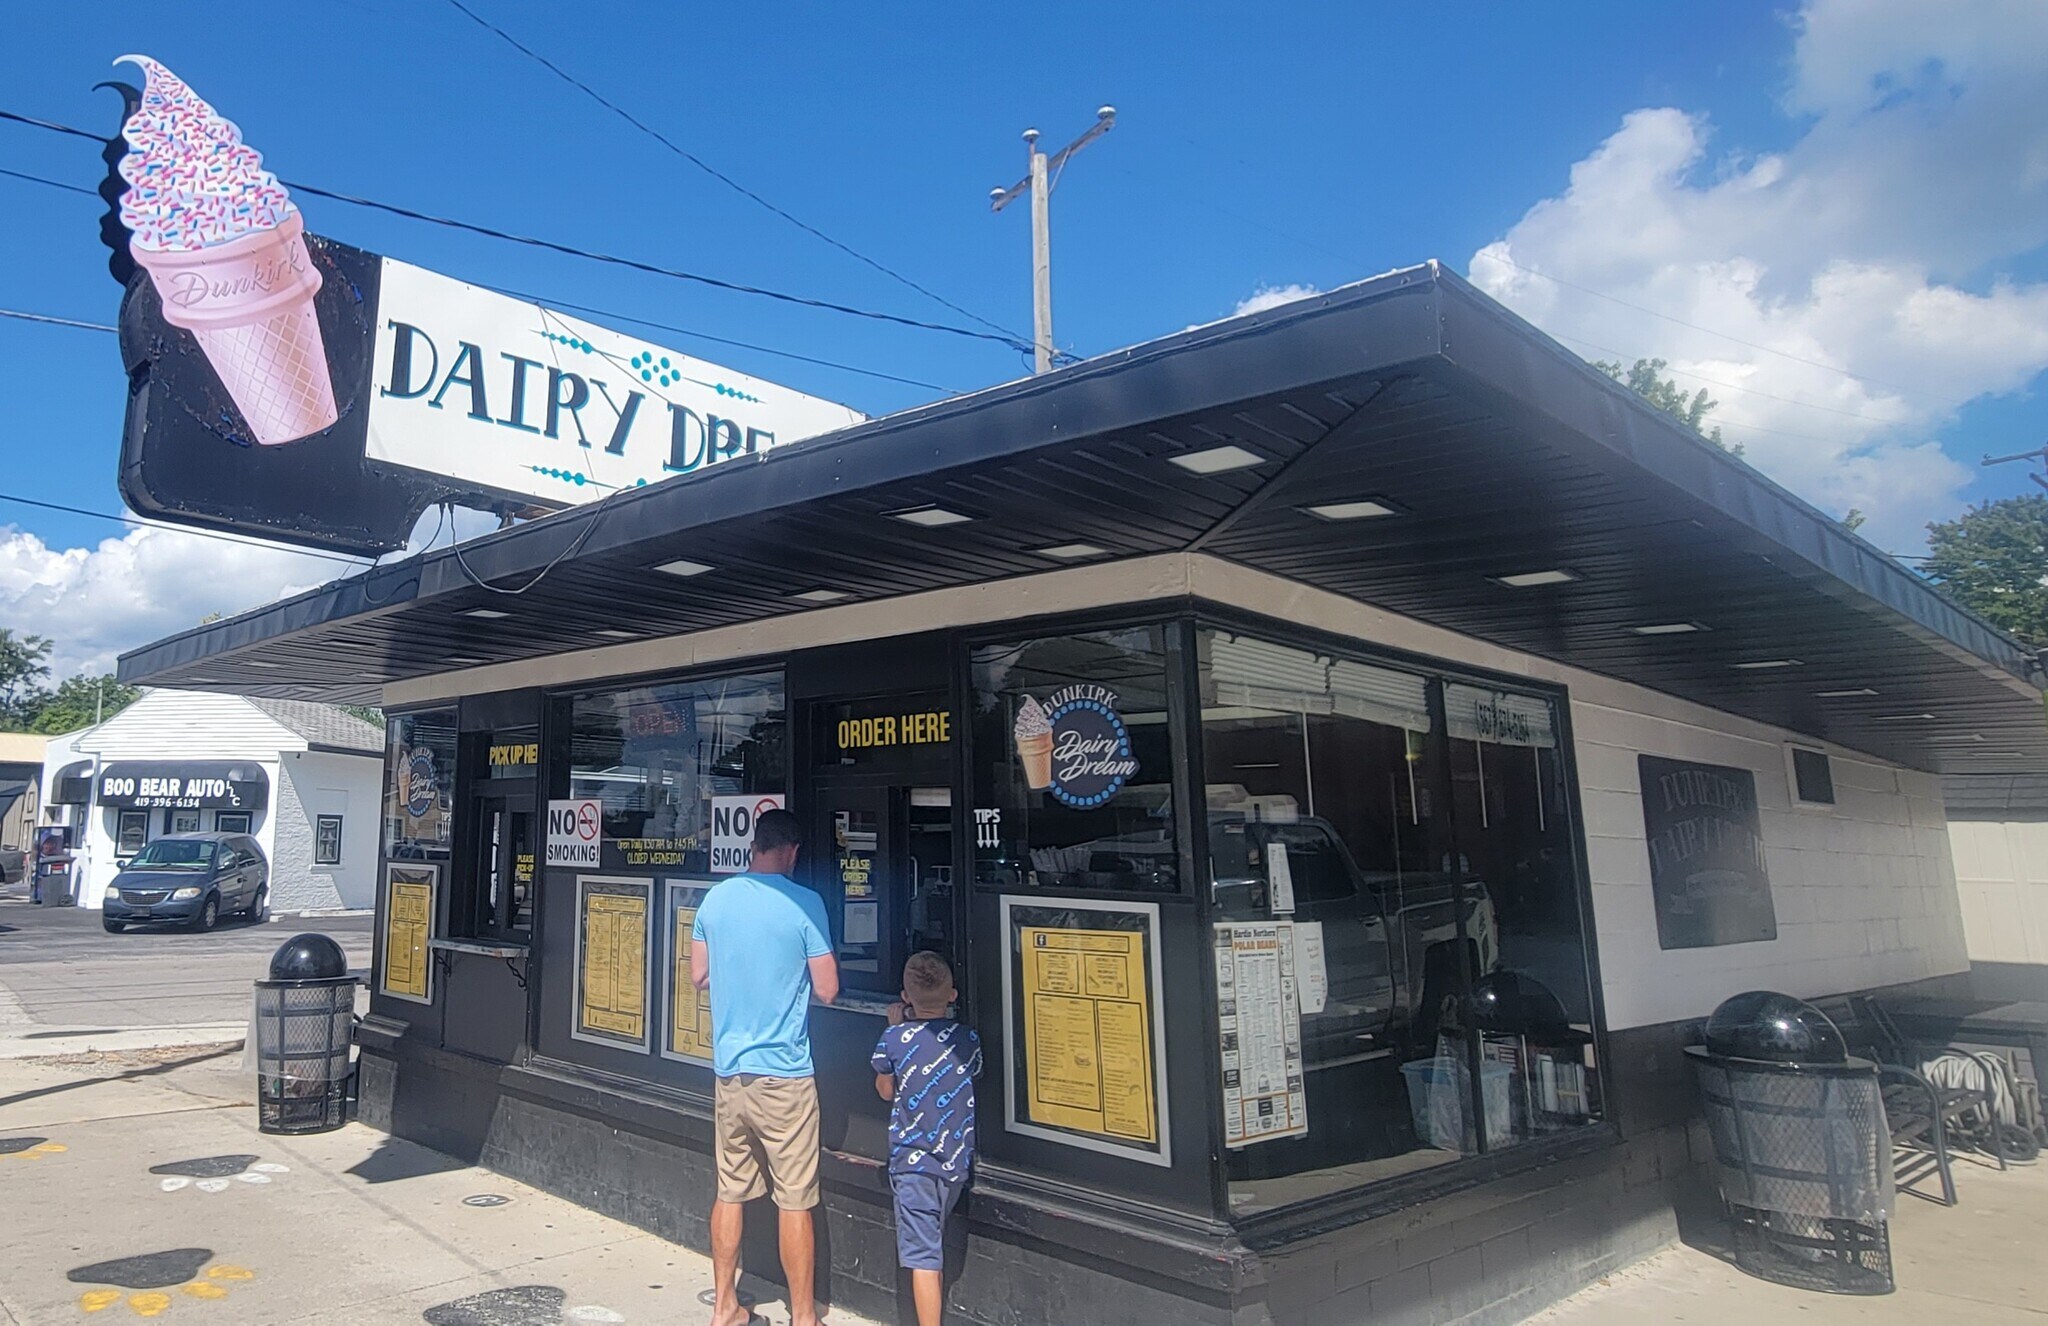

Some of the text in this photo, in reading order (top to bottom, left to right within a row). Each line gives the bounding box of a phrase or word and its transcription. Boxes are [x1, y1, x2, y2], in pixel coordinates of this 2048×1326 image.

[169, 241, 304, 308] Dunkirk
[381, 318, 645, 456] DAIRY
[1043, 684, 1118, 716] DUNKIRK
[636, 710, 687, 735] OPEN
[838, 711, 950, 749] ORDER HERE
[489, 743, 538, 766] PICK UP HE
[1053, 730, 1119, 762] Dairy
[1058, 753, 1136, 782] Dream
[103, 778, 135, 796] BOO
[139, 778, 181, 797] BEAR
[185, 778, 225, 797] AUTO
[134, 797, 200, 808] 419-396-6134
[549, 809, 576, 835] NO
[714, 807, 750, 837] NO
[973, 808, 1001, 823] TIPS
[547, 845, 599, 862] SMOKING!
[840, 858, 870, 870] PLEASE
[842, 871, 868, 883] ORDER
[845, 884, 866, 896] HERE
[908, 1063, 953, 1110] Champion
